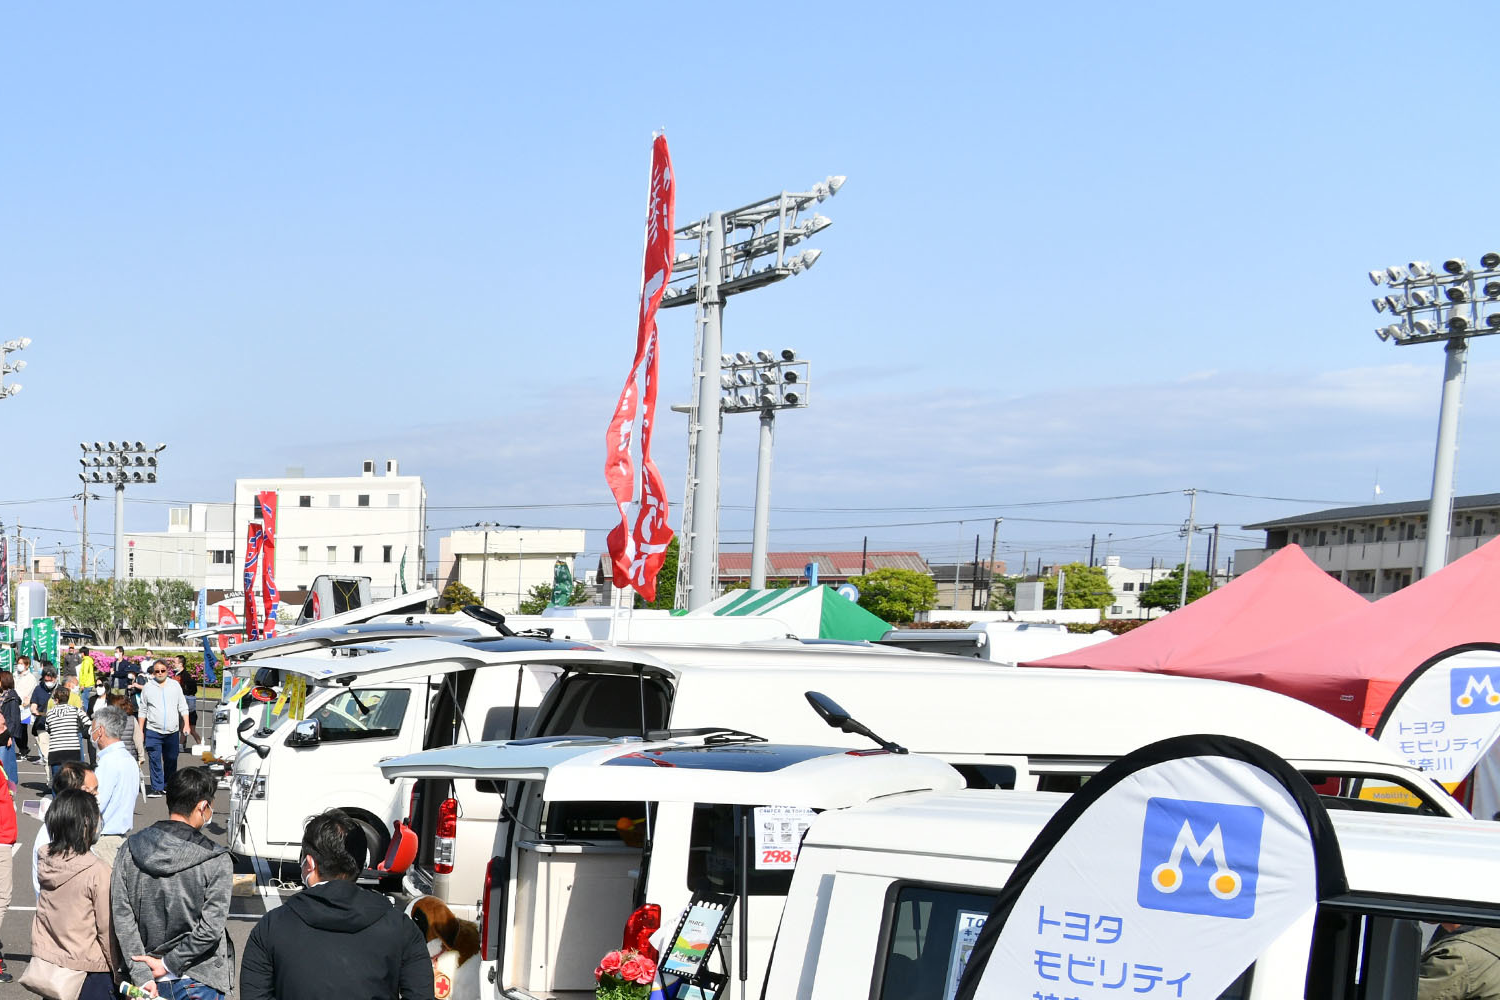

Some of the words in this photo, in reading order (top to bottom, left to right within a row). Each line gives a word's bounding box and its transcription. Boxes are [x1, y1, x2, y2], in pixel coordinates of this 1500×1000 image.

[1399, 720, 1446, 735] トヨタ
[1399, 738, 1483, 754] モビリティ
[762, 849, 792, 864] 298
[1037, 905, 1124, 944] トヨタ
[1033, 949, 1192, 998] モビリティ
